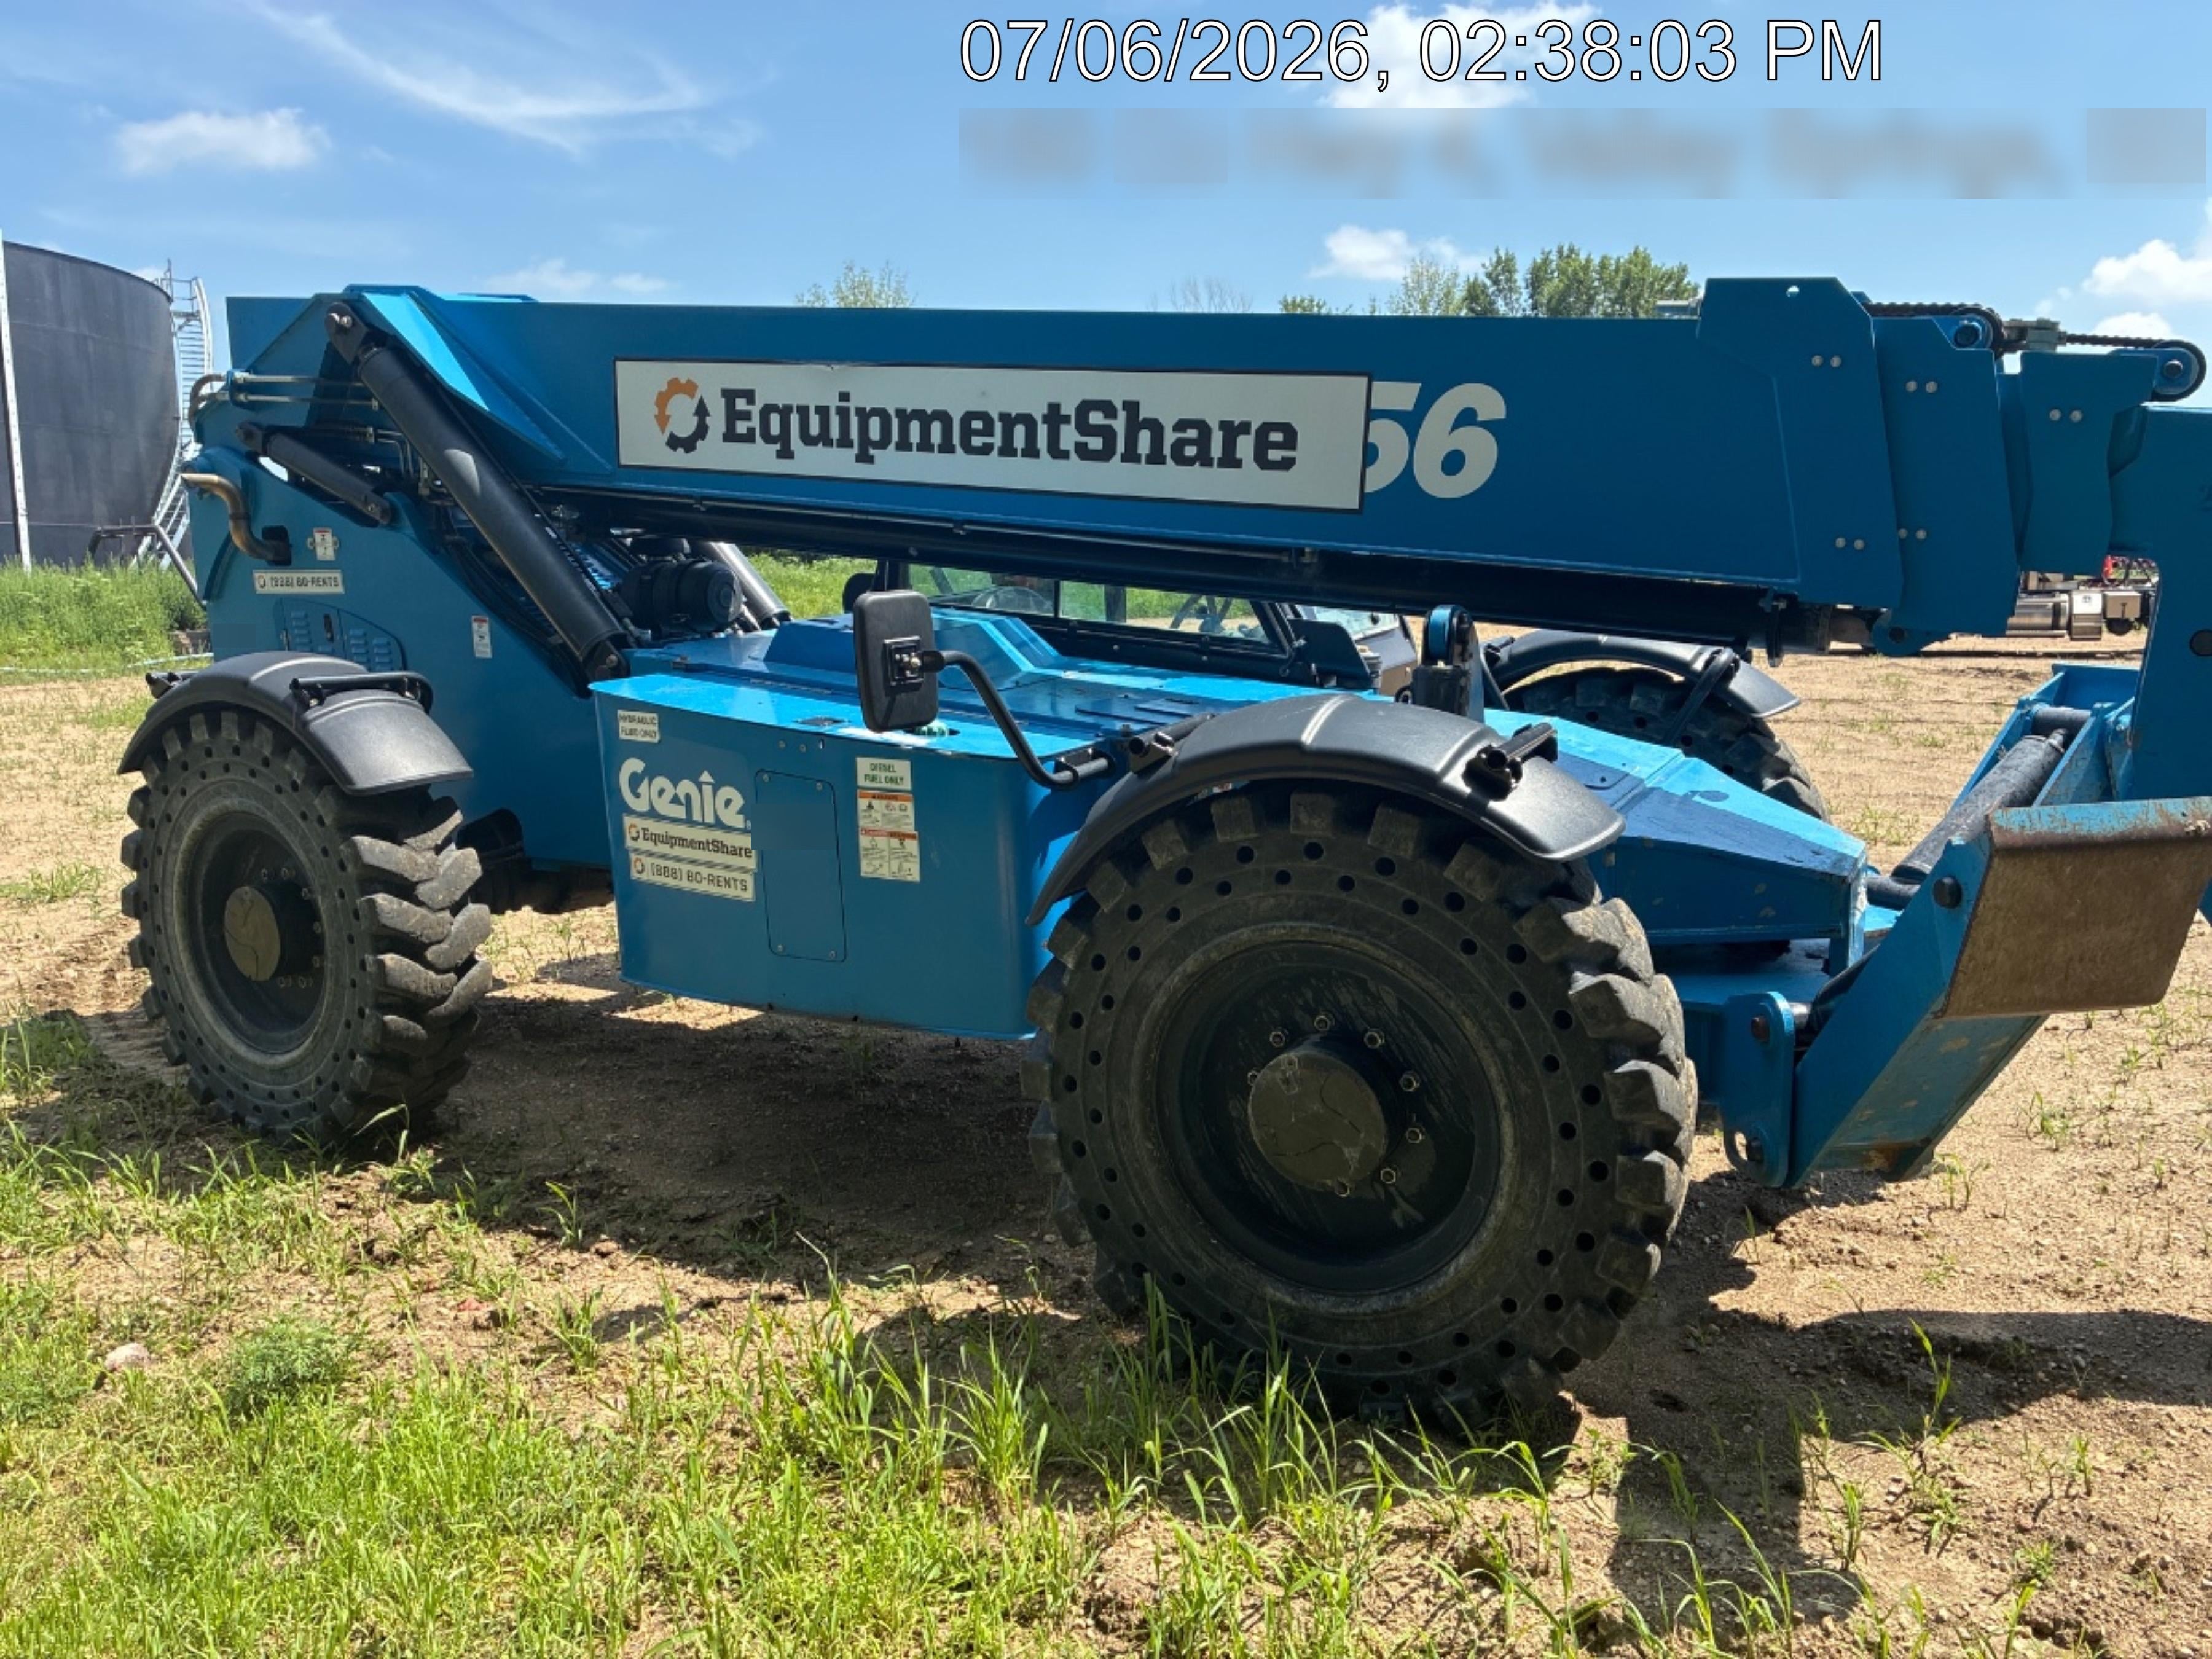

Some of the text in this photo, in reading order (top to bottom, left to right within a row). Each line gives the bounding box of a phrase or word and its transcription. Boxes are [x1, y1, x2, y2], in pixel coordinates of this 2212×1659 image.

[721, 388, 1298, 472] EquipmentShare
[864, 774, 904, 786] FUEL ONLY
[869, 762, 896, 773] DIESEL
[619, 757, 745, 829] Genie
[641, 827, 753, 858] EquipmentShare
[650, 862, 683, 882] (888)
